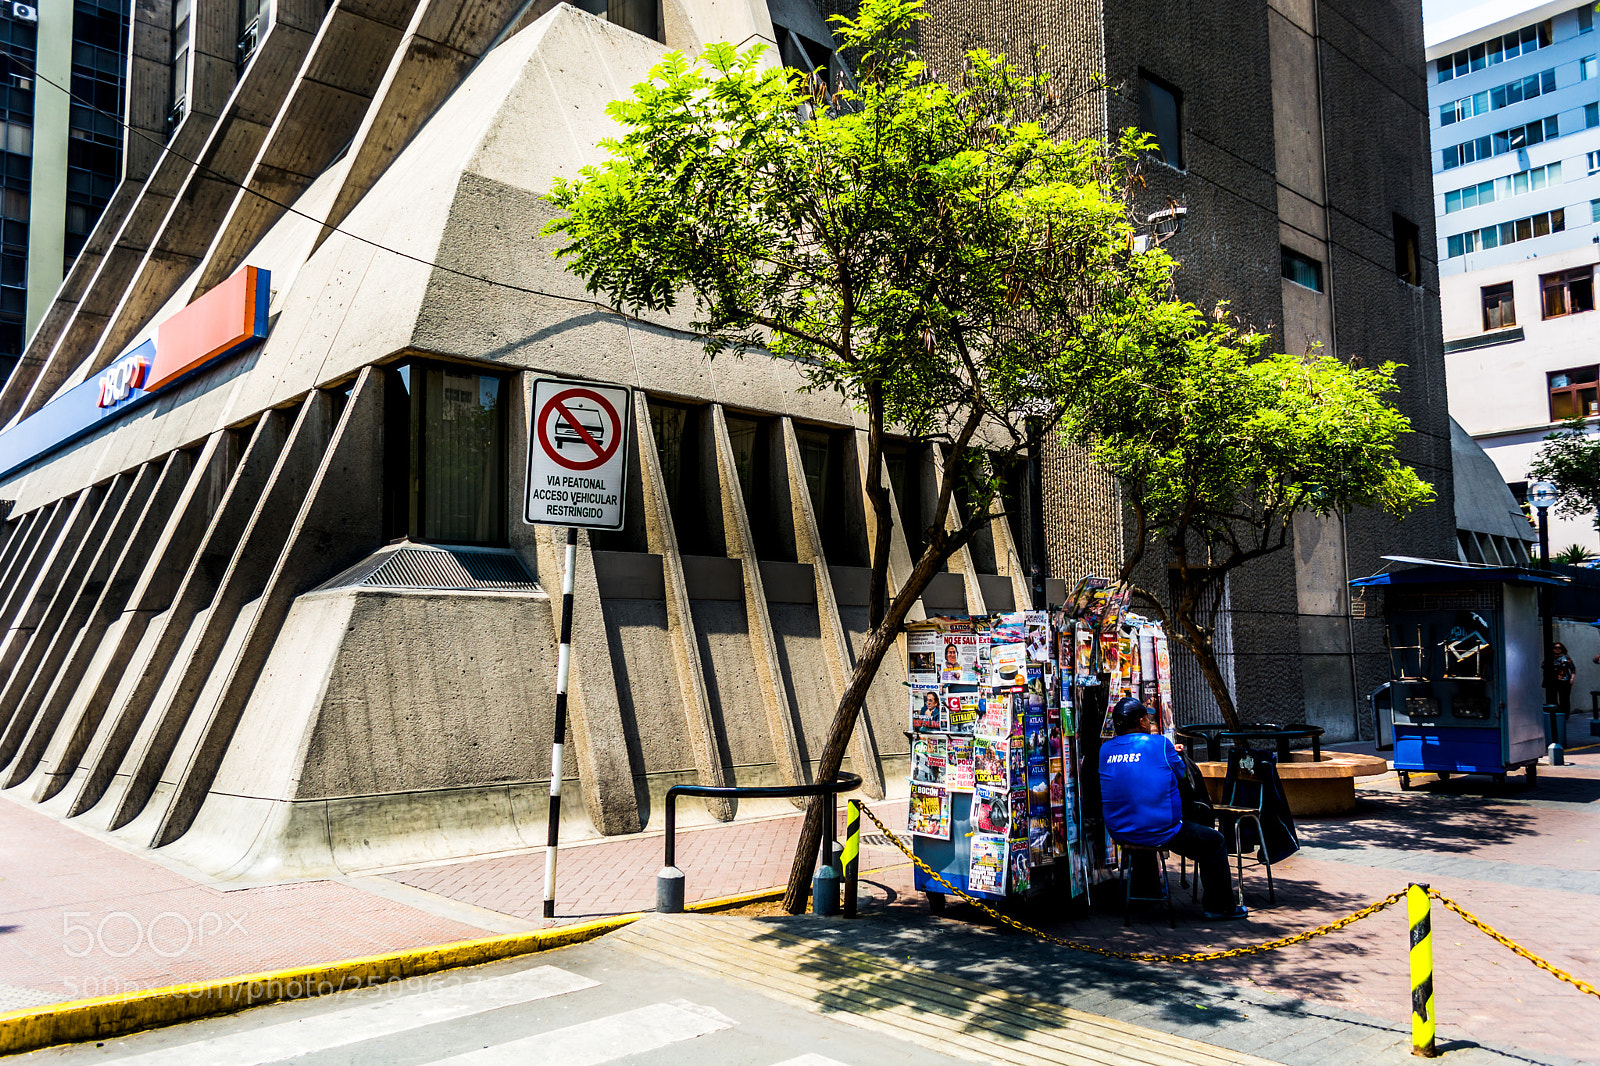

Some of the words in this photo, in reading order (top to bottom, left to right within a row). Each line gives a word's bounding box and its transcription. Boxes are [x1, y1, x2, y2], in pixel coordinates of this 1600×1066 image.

[547, 475, 561, 487] VIA
[563, 477, 606, 490] PEATONAL
[533, 489, 569, 501] ACCESO
[570, 491, 617, 505] VEHICULAR
[547, 504, 603, 518] RESTRINGIDO
[944, 636, 953, 644] NO
[1107, 752, 1142, 764] ANDRES
